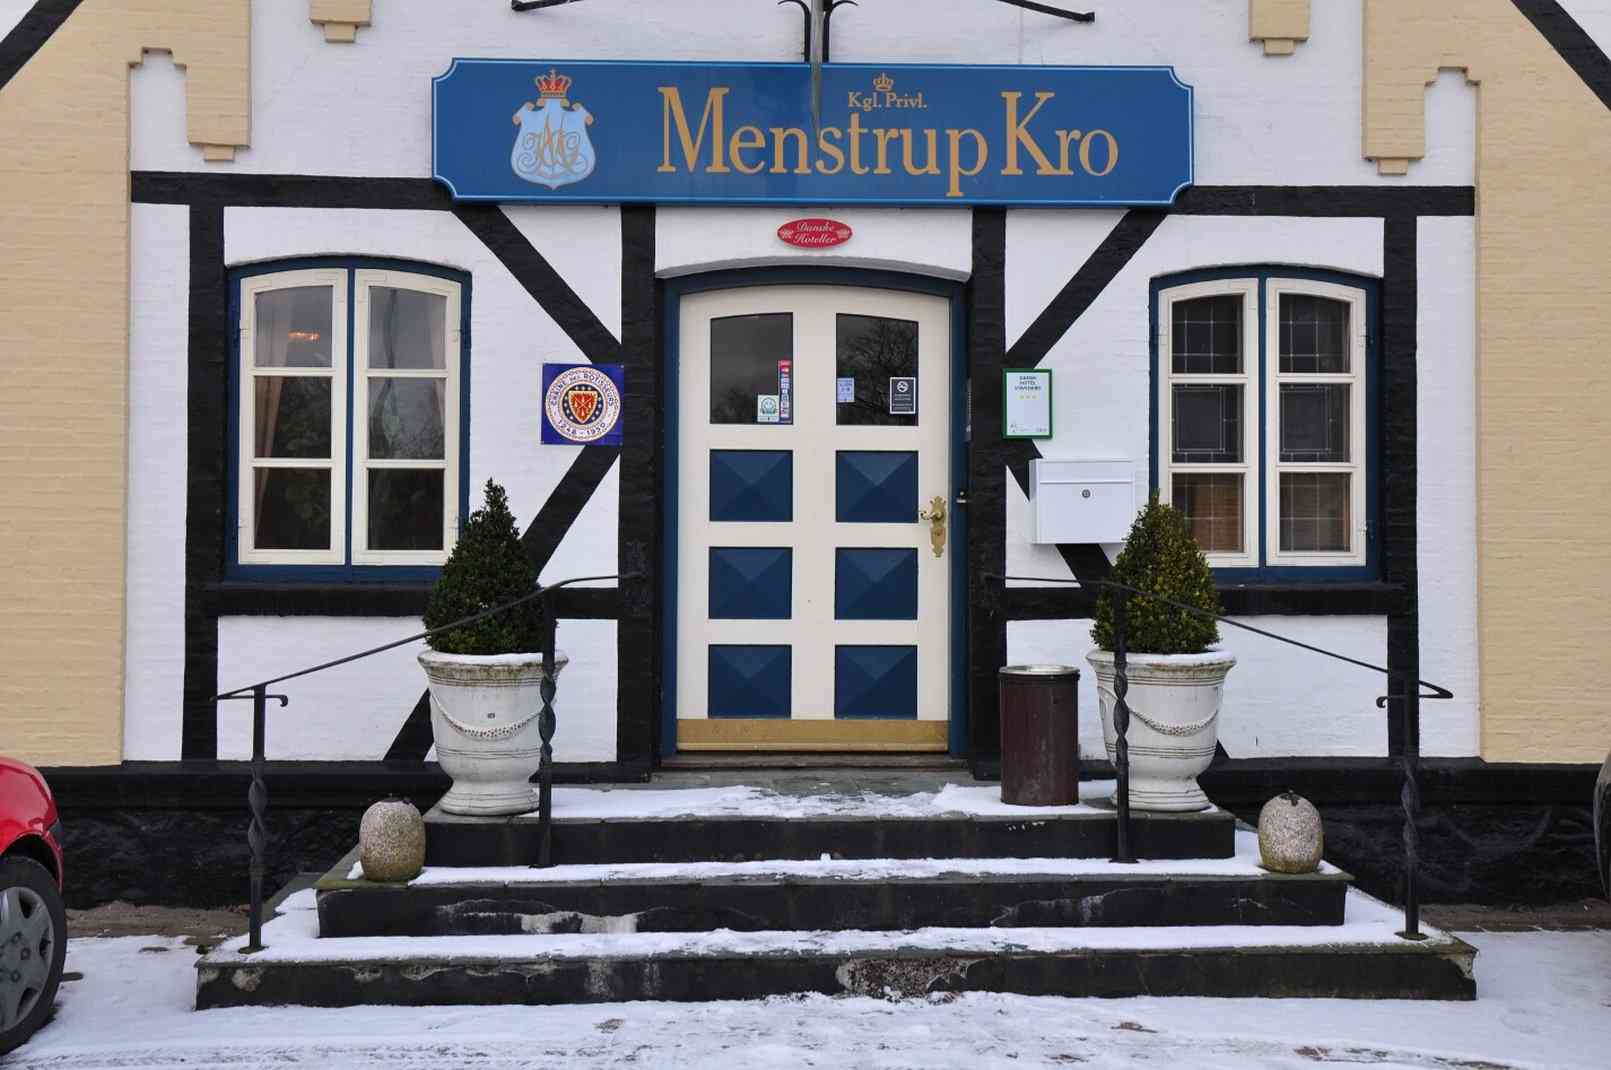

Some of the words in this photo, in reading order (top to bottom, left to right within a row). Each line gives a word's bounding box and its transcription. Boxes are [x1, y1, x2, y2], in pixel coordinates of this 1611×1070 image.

[848, 92, 882, 111] Kgl.
[885, 92, 928, 108] Privl.
[656, 86, 989, 197] Menstrup
[1000, 91, 1119, 177] Kro
[797, 222, 833, 232] Danske
[793, 232, 836, 244] Hoteller
